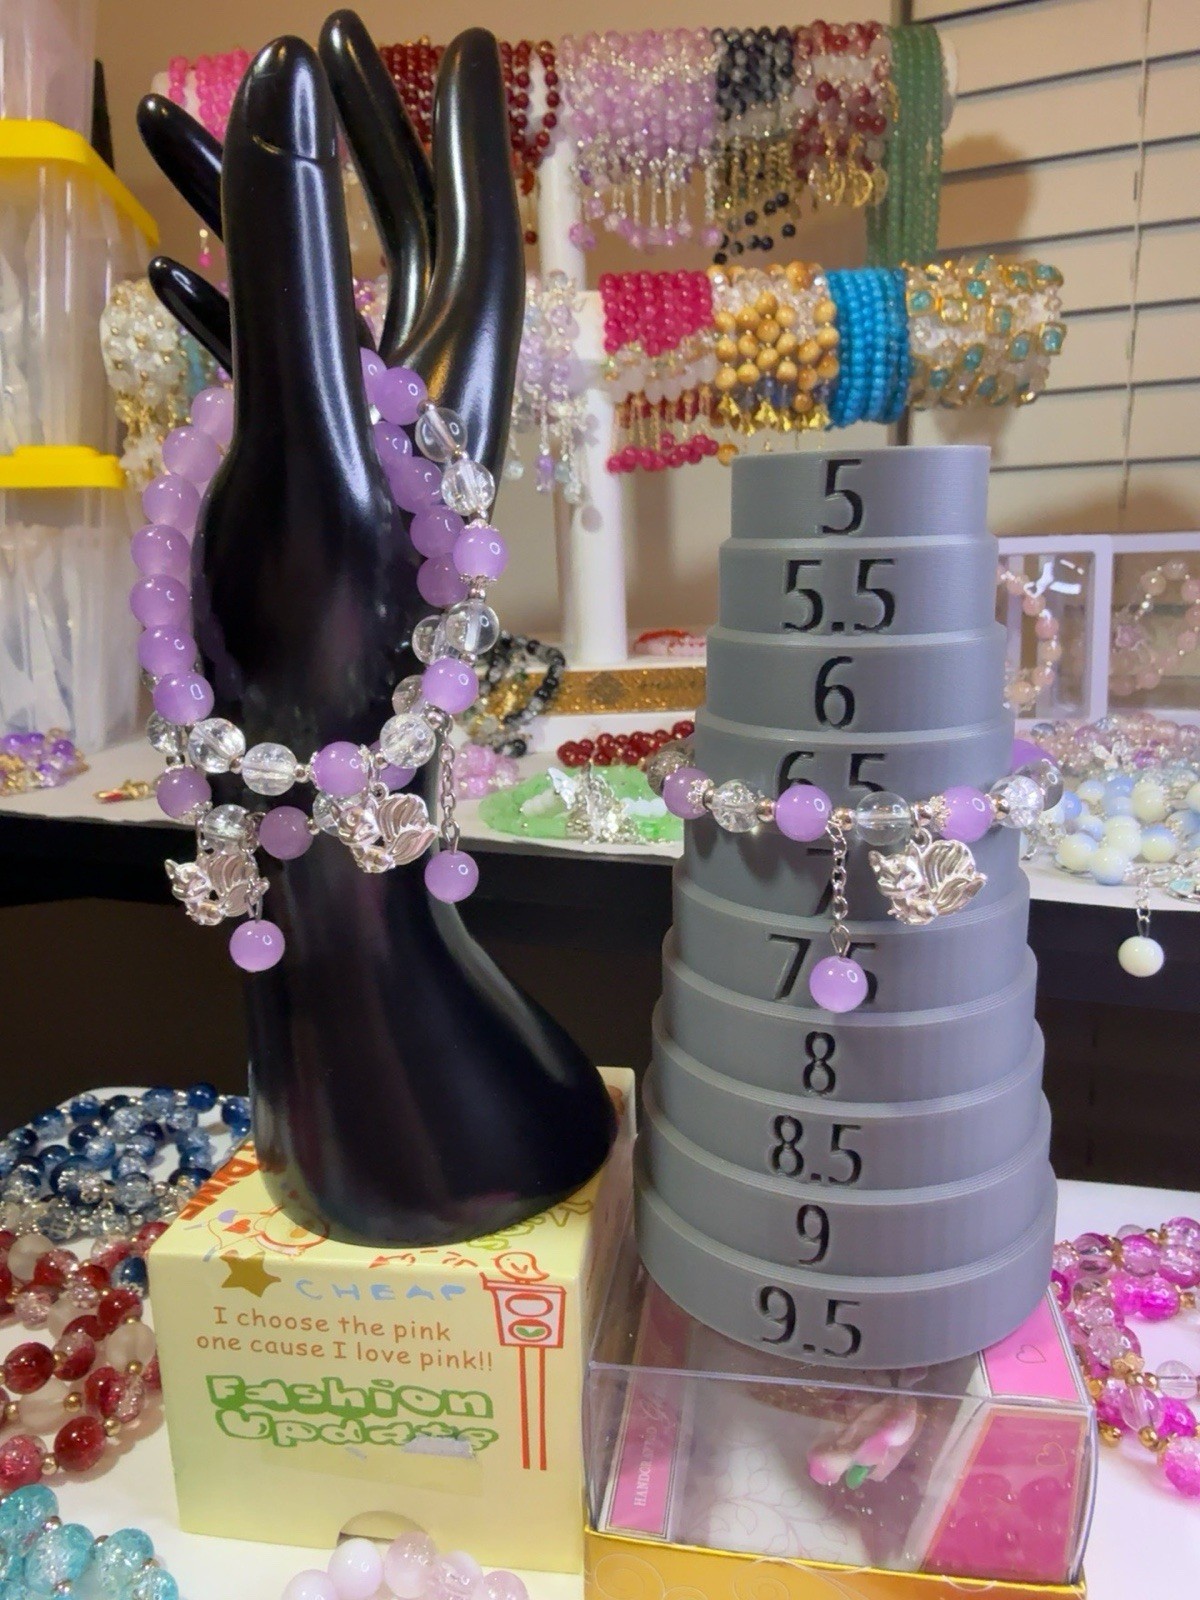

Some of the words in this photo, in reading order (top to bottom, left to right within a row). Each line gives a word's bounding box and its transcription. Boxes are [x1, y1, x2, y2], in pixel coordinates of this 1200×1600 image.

[820, 458, 864, 536] 5
[782, 558, 896, 633] 5.5
[814, 656, 856, 730] 6
[802, 1031, 837, 1096] 8
[769, 1114, 863, 1186] 8.5
[795, 1204, 831, 1266] 9
[213, 1305, 227, 1325] I
[236, 1308, 330, 1332] choose
[338, 1315, 385, 1337] the
[394, 1321, 452, 1342] pink
[295, 1278, 467, 1301] CHEAP
[757, 1285, 862, 1358] 9.5
[196, 1334, 242, 1351] one
[250, 1338, 324, 1358] cause
[333, 1341, 347, 1359] I
[357, 1342, 412, 1365] love
[420, 1350, 493, 1371] pink!!
